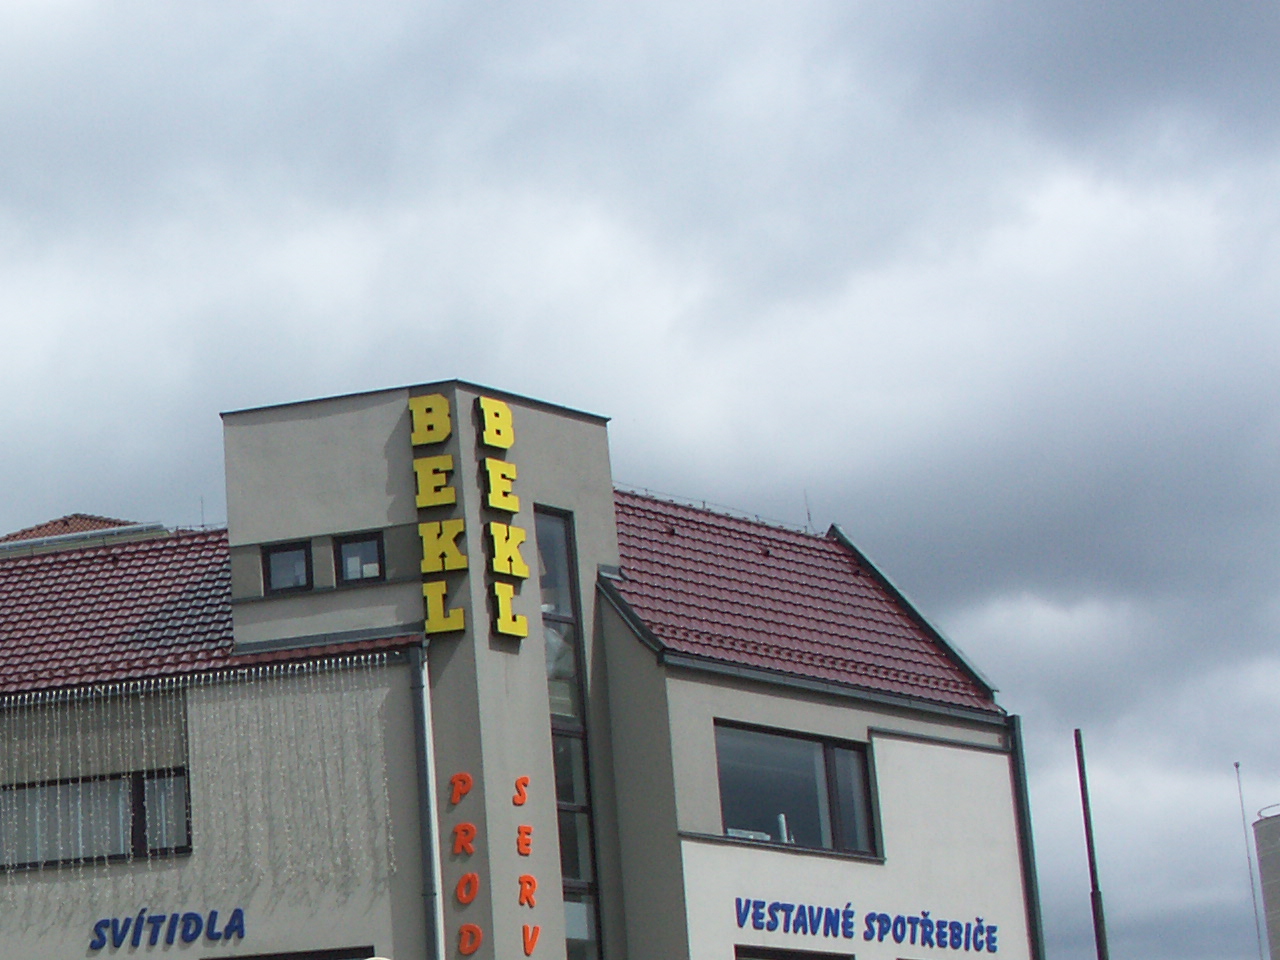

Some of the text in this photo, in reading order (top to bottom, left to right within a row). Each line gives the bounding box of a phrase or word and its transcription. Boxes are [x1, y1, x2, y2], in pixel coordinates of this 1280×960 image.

[408, 392, 468, 634] BEKL
[478, 396, 529, 638] BEKL
[89, 907, 245, 950] SVÍTIDLA
[735, 897, 998, 953] VESTAVNÉ SPOTŘEBIČE
